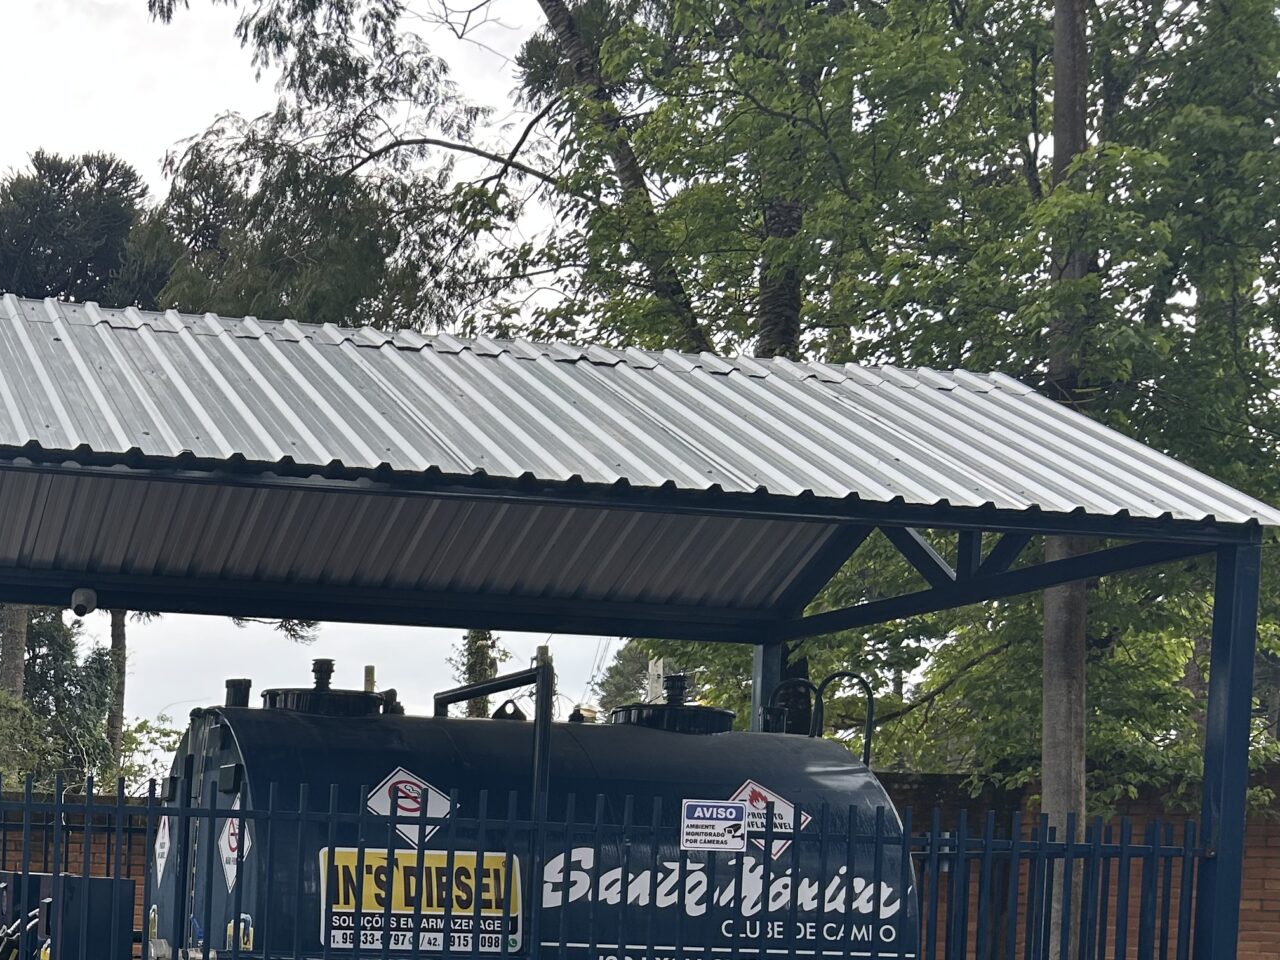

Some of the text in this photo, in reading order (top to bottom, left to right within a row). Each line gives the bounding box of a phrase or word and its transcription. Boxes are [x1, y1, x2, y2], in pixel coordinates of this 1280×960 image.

[693, 806, 736, 819] AVISO
[747, 812, 784, 820] PRODTO
[700, 837, 728, 845] CÂMERAS
[403, 866, 506, 909] DIESEL
[332, 914, 397, 930] SOLÇÕS
[721, 920, 784, 939] CUE
[823, 923, 896, 943] CAMO
